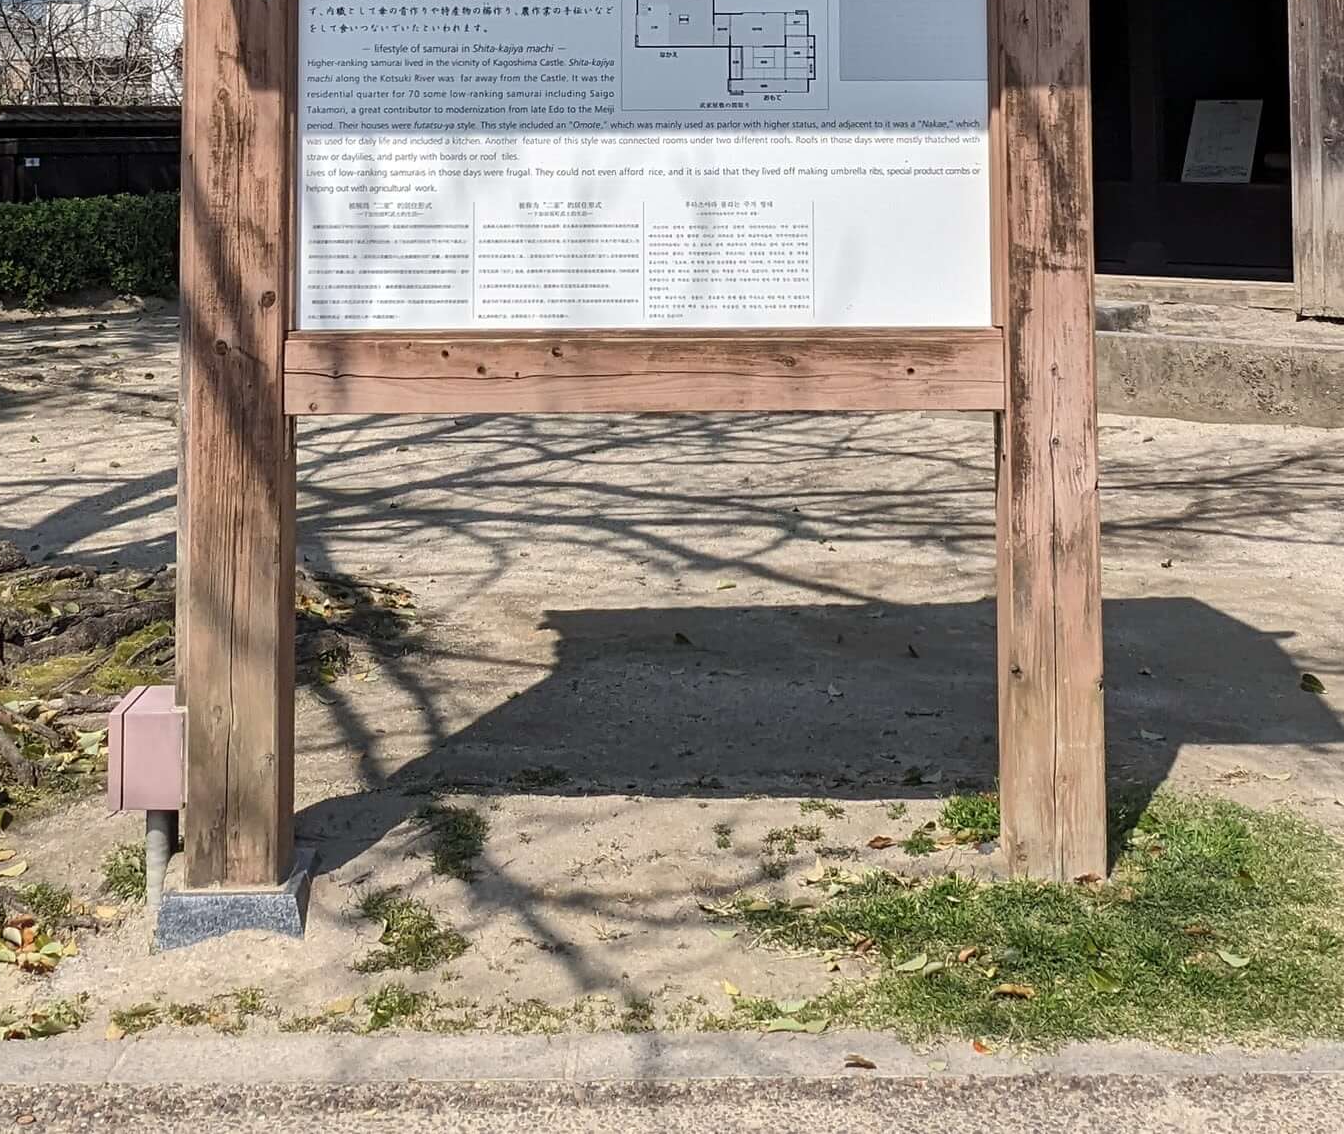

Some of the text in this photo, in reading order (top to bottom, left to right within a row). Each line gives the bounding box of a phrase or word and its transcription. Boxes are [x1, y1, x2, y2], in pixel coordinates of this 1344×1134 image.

[308, 23, 489, 34] をして食いつないでいたといわれます。
[375, 43, 553, 56] lifestyle samurai Shita-kajiya machi
[307, 57, 615, 70] Higher-ranking samurai lived the vicinity Kagoshima Castle. Shita-kajiya
[307, 73, 333, 83] machi
[336, 73, 360, 85] along
[363, 73, 377, 83] the
[380, 73, 411, 82] Kotsuki
[414, 73, 435, 82] River
[460, 73, 472, 82] far
[475, 76, 498, 85] away
[500, 73, 520, 82] from
[524, 73, 538, 82] the
[541, 72, 568, 82] Castle.
[601, 72, 615, 82] the
[306, 89, 353, 98] residential
[356, 90, 389, 101] quarter
[392, 88, 406, 98] for
[409, 88, 420, 98] 70
[450, 88, 503, 100] low-ranking
[506, 89, 541, 98] samurai
[545, 88, 586, 100] including
[590, 88, 615, 100] Saigo
[306, 103, 615, 116] Takamori, great contributor modernization from late Edo the Meiji
[306, 120, 335, 132] period.
[337, 120, 358, 130] Their
[361, 120, 389, 130] houses
[414, 120, 455, 132] futatsu-ya
[457, 119, 478, 132] style.
[480, 119, 496, 129] This
[498, 119, 517, 132] style
[519, 119, 553, 129] included
[569, 119, 607, 130] "Omote,"
[610, 119, 634, 129] which
[655, 119, 682, 131] mainly
[684, 119, 703, 129] used
[717, 119, 741, 131] parlor
[743, 119, 761, 129] with
[764, 119, 790, 131] higher
[792, 120, 819, 130] status,
[821, 118, 836, 128] and
[839, 118, 873, 131] adjacent
[918, 118, 953, 129] "Nakae,"
[955, 118, 980, 128] which
[324, 135, 343, 145] used
[392, 135, 407, 145] and
[409, 135, 443, 145] included
[452, 135, 483, 145] kitchen.
[485, 135, 517, 145] Another
[522, 135, 551, 144] feature
[564, 135, 579, 144] this
[581, 135, 599, 147] style
[619, 135, 660, 144] connected
[690, 134, 713, 144] under
[716, 135, 731, 144] two
[734, 134, 768, 144] different
[771, 134, 793, 144] roofs.
[795, 134, 818, 144] Roofs
[831, 134, 852, 144] those
[854, 134, 872, 146] days
[896, 134, 923, 146] mostly
[925, 134, 960, 143] thatched
[962, 134, 980, 143] with
[306, 151, 520, 163] straw daylilies, and partly with boards roof tiles.
[306, 167, 325, 177] Lives
[339, 167, 387, 179] low-ranking
[390, 168, 426, 176] samurais
[439, 166, 461, 176] those
[463, 166, 482, 179] days
[507, 166, 532, 179] frugal.
[535, 166, 554, 179] They
[556, 166, 579, 176] could
[582, 167, 595, 176] not
[619, 166, 644, 176] afford
[648, 167, 666, 177] rice,
[668, 166, 684, 176] and
[704, 166, 720, 176] said
[723, 166, 739, 176] that
[742, 166, 760, 178] they
[762, 166, 781, 175] lived
[784, 166, 795, 175] off
[798, 165, 828, 178] making
[831, 165, 867, 175] umbrella
[869, 165, 885, 177] ribs,
[887, 165, 912, 178] special
[914, 165, 943, 178] product
[945, 165, 970, 175] combs
[306, 182, 437, 195] helping out with agricultural work.
